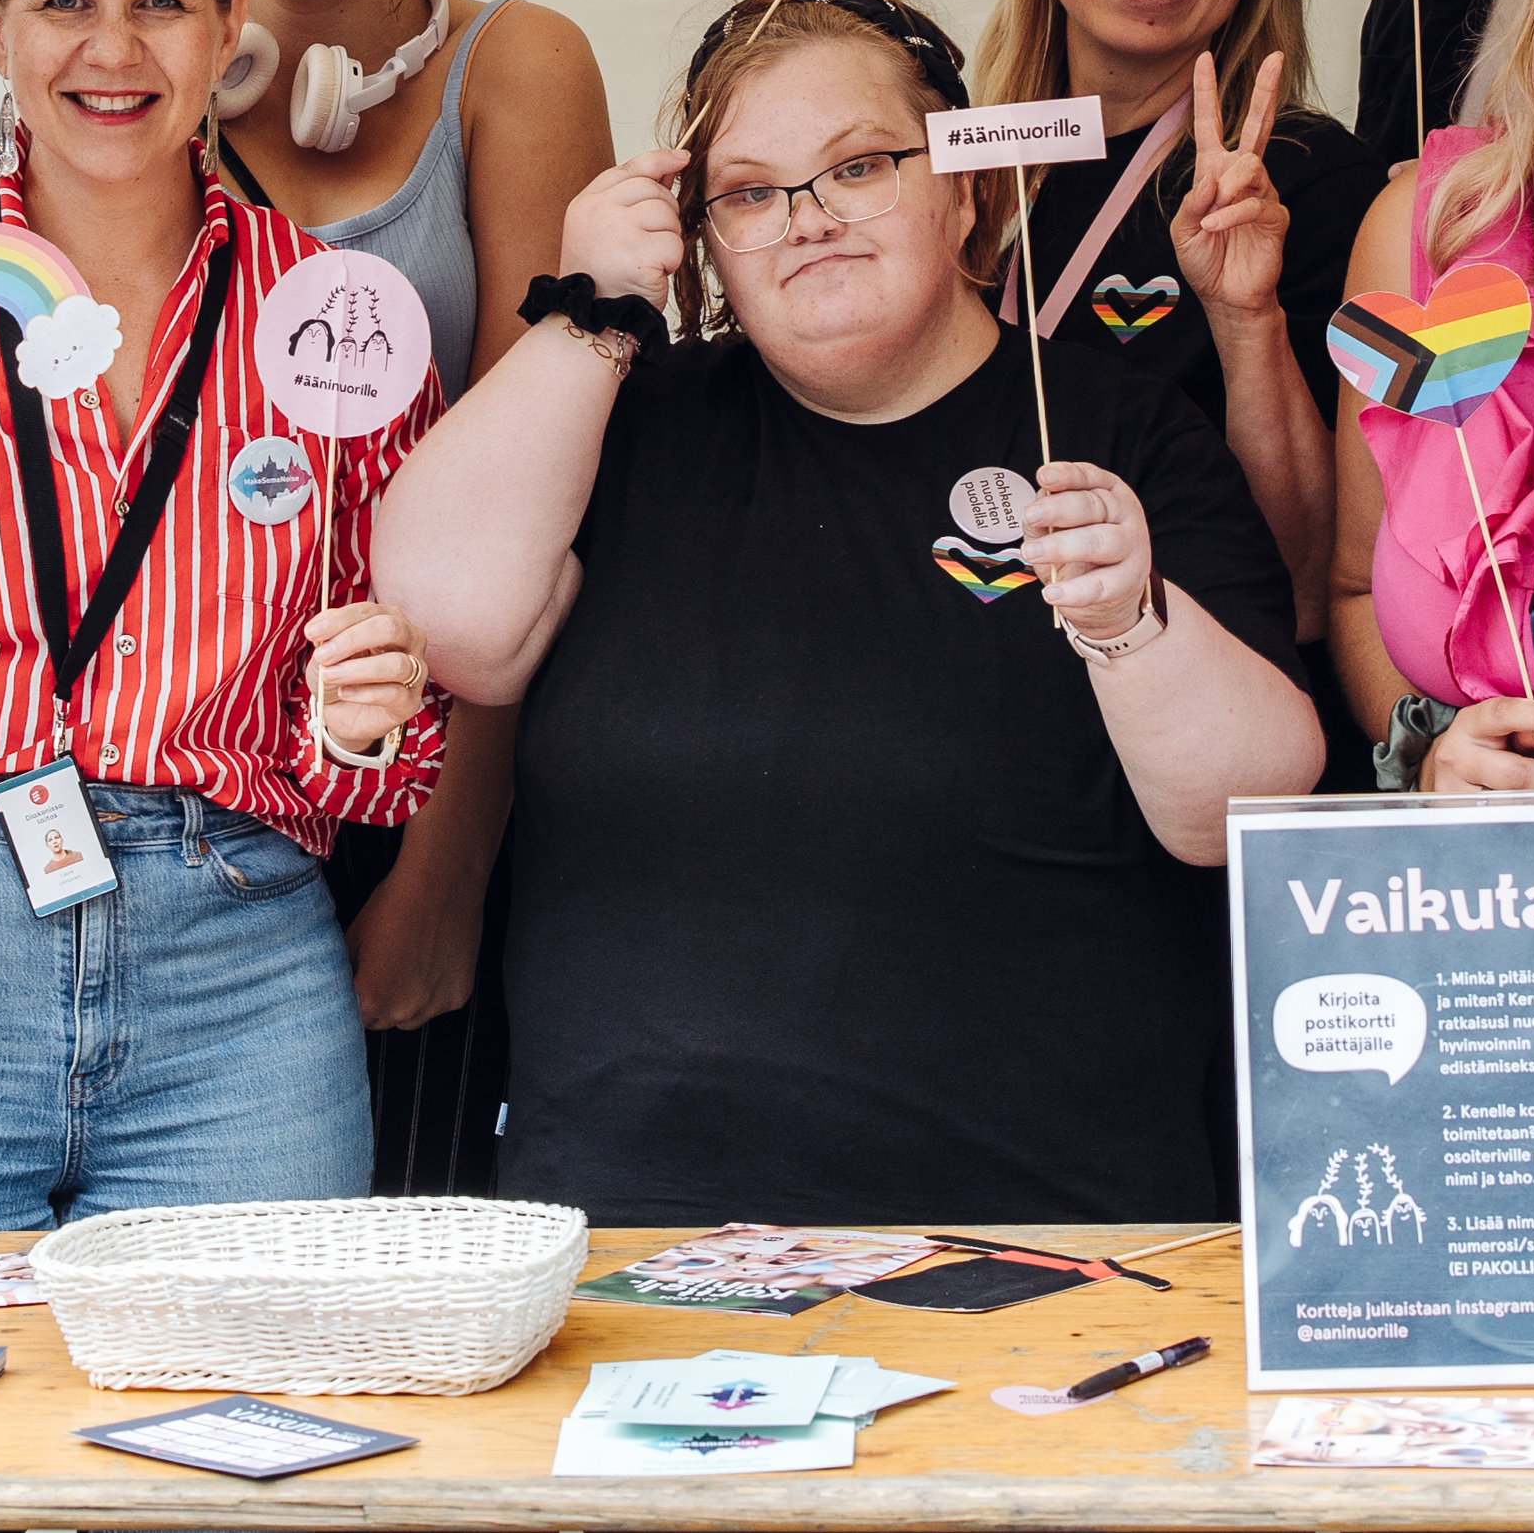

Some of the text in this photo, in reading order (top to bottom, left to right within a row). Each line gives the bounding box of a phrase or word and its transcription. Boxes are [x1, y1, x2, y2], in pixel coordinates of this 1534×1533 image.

[947, 119, 1081, 147] #ääninuorille
[294, 373, 378, 398] #ääninuorille
[243, 475, 300, 486] MakeSomeNoise
[960, 481, 988, 529] puolella!
[980, 480, 1000, 525] nuorten
[993, 472, 1020, 529] Rohkeasti
[1436, 972, 1448, 986] 1.
[1451, 971, 1495, 985] Minkä
[1318, 992, 1380, 1009] Kirjoita
[1437, 995, 1451, 1011] ja
[1454, 993, 1504, 1008] miten?
[1305, 1014, 1396, 1033] postikortti
[1438, 1015, 1509, 1030] ratkaisusi
[1304, 1037, 1394, 1056] päättäjälle
[1439, 1037, 1531, 1055] hyvinvoinnin
[1442, 1105, 1457, 1119] 2.
[1460, 1104, 1516, 1119] Kenelle
[1444, 1148, 1531, 1164] osoiteriville
[1445, 1172, 1477, 1186] nimi
[1481, 1171, 1495, 1188] ja
[1447, 1216, 1462, 1231] 3.
[1466, 1215, 1504, 1231] Lisää
[1449, 1261, 1468, 1277] (EI
[1296, 1302, 1362, 1321] Kortteja
[1366, 1300, 1451, 1320] julkaistaan
[1297, 1323, 1409, 1342] @aaninuorille
